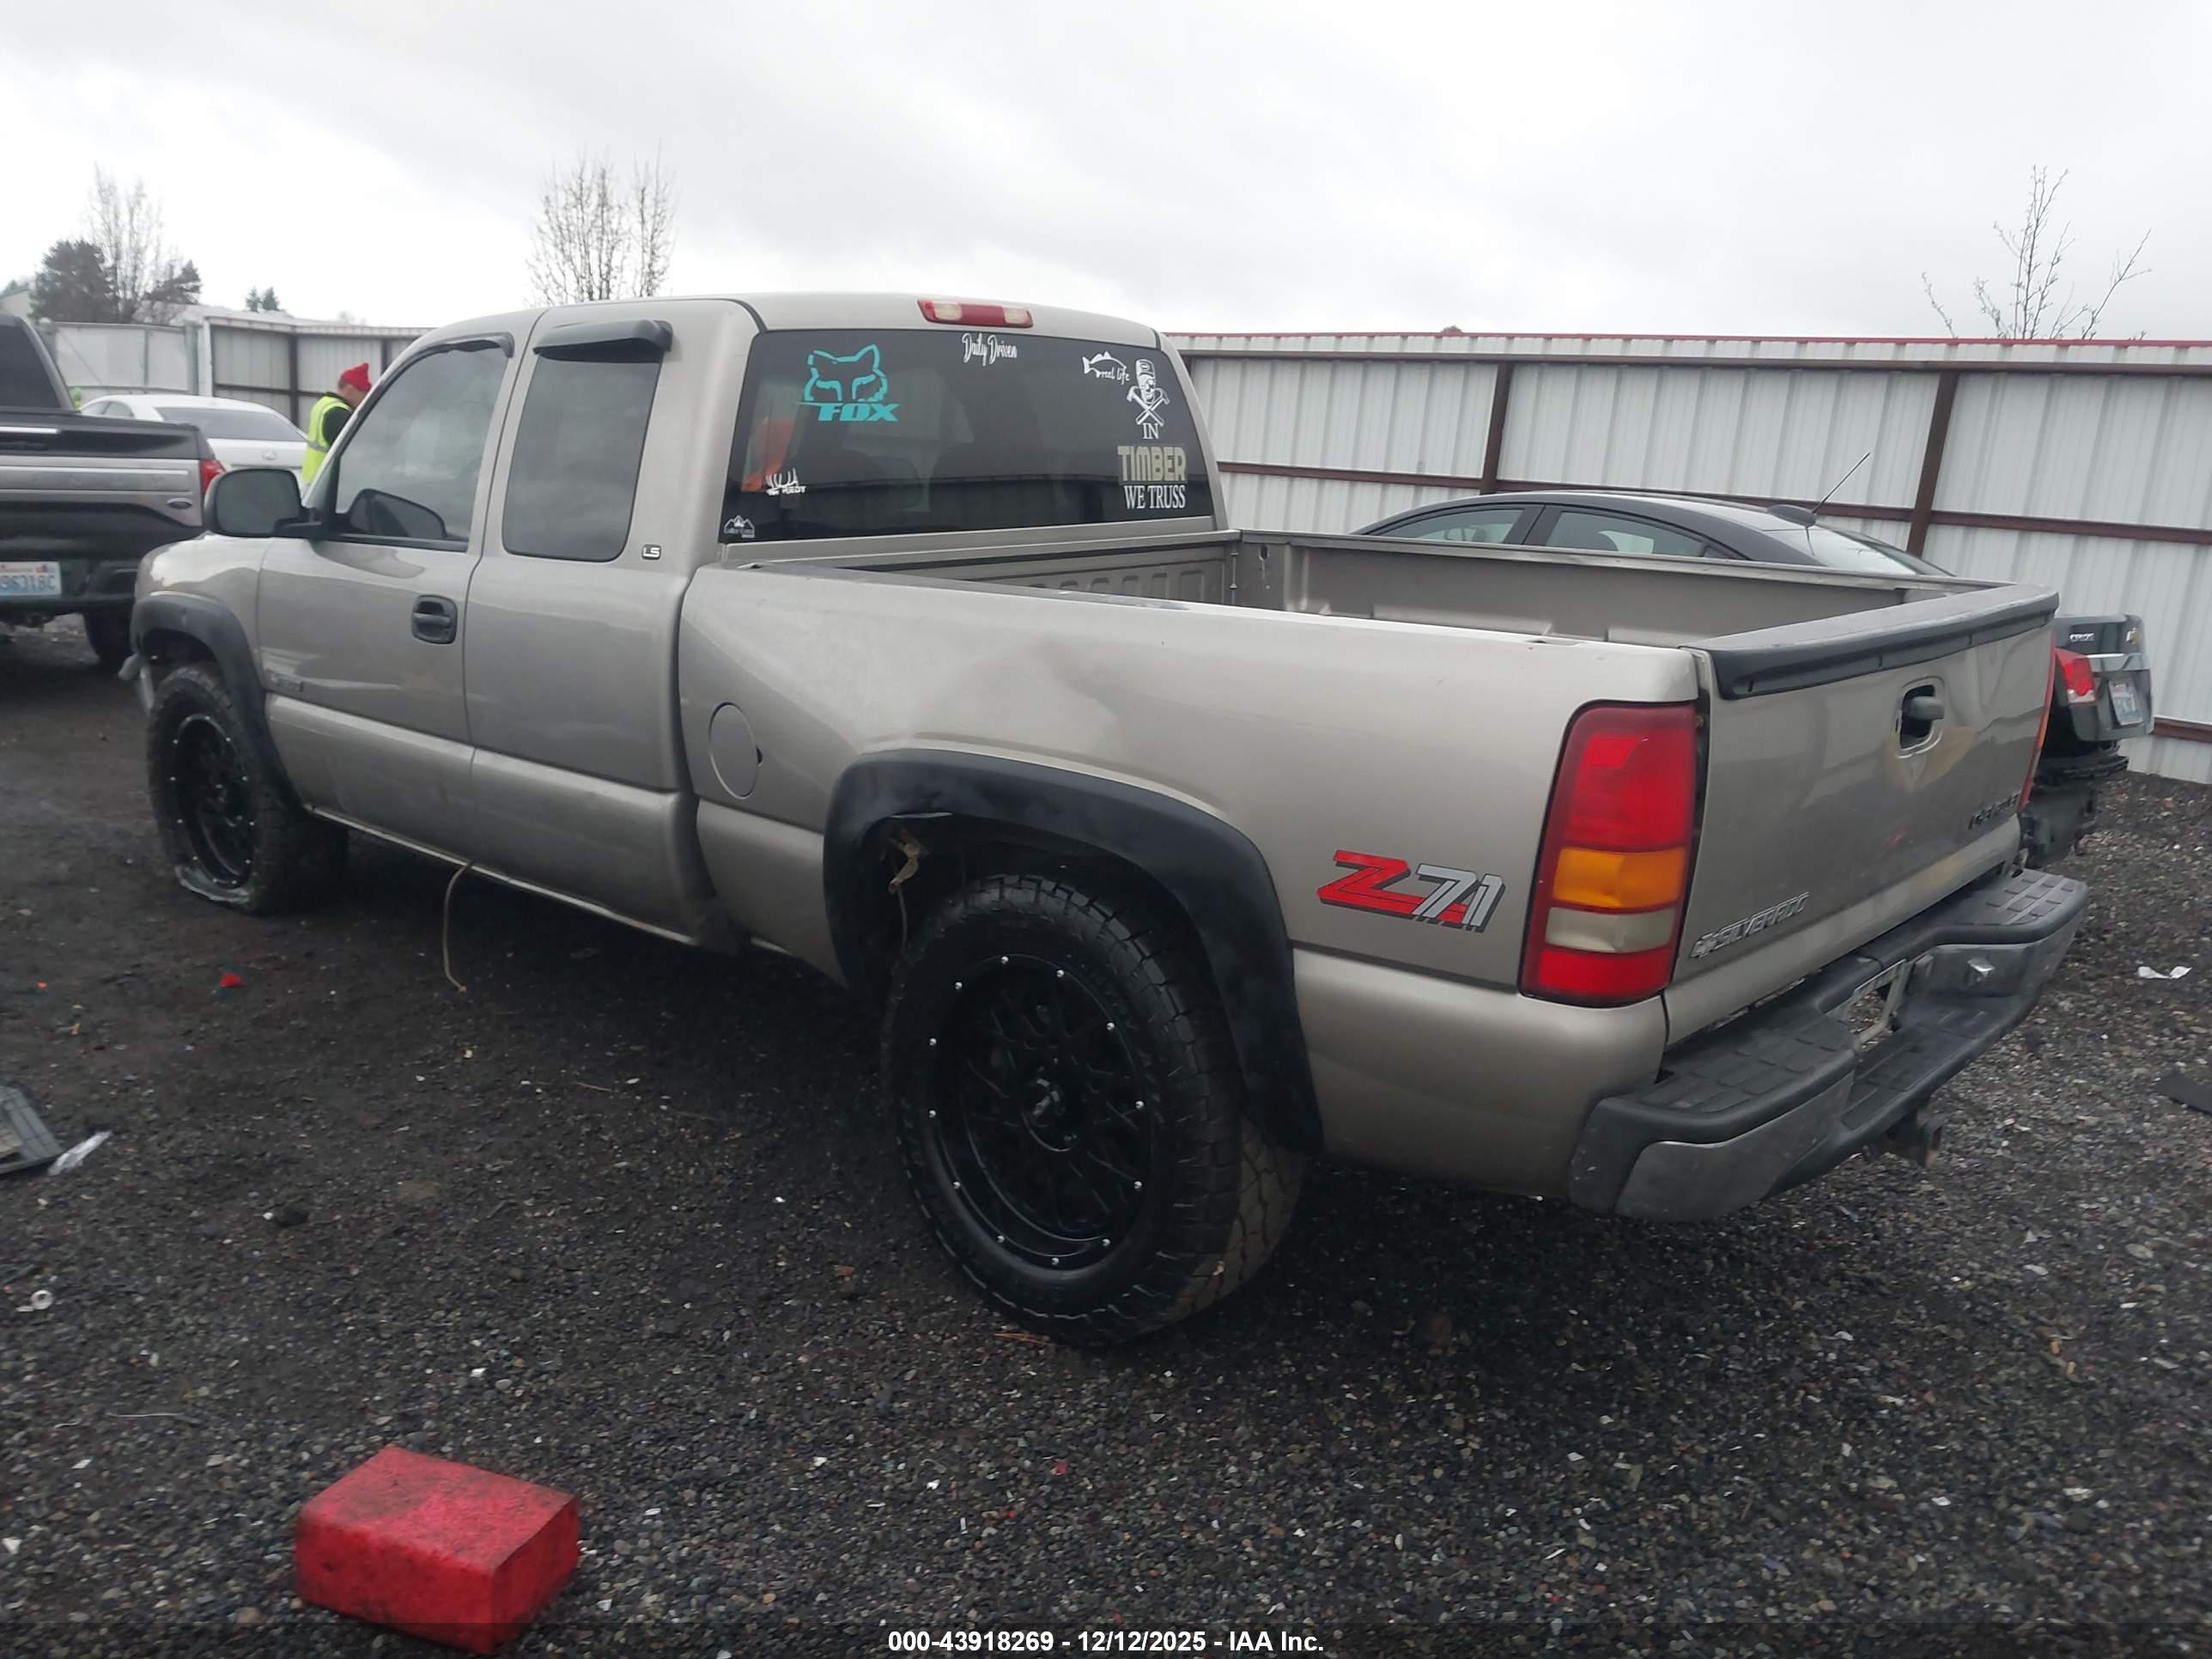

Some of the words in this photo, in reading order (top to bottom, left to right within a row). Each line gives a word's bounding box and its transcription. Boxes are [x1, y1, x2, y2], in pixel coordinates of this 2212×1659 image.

[962, 332, 988, 367] Daily
[987, 334, 1018, 364] Driven
[817, 402, 900, 422] FOX
[1142, 422, 1159, 439] IN
[1117, 445, 1187, 482] TIMBER
[1123, 485, 1146, 509] WE
[1149, 484, 1186, 508] TRUSS
[642, 546, 659, 558] LS
[1317, 849, 1505, 933] Z71
